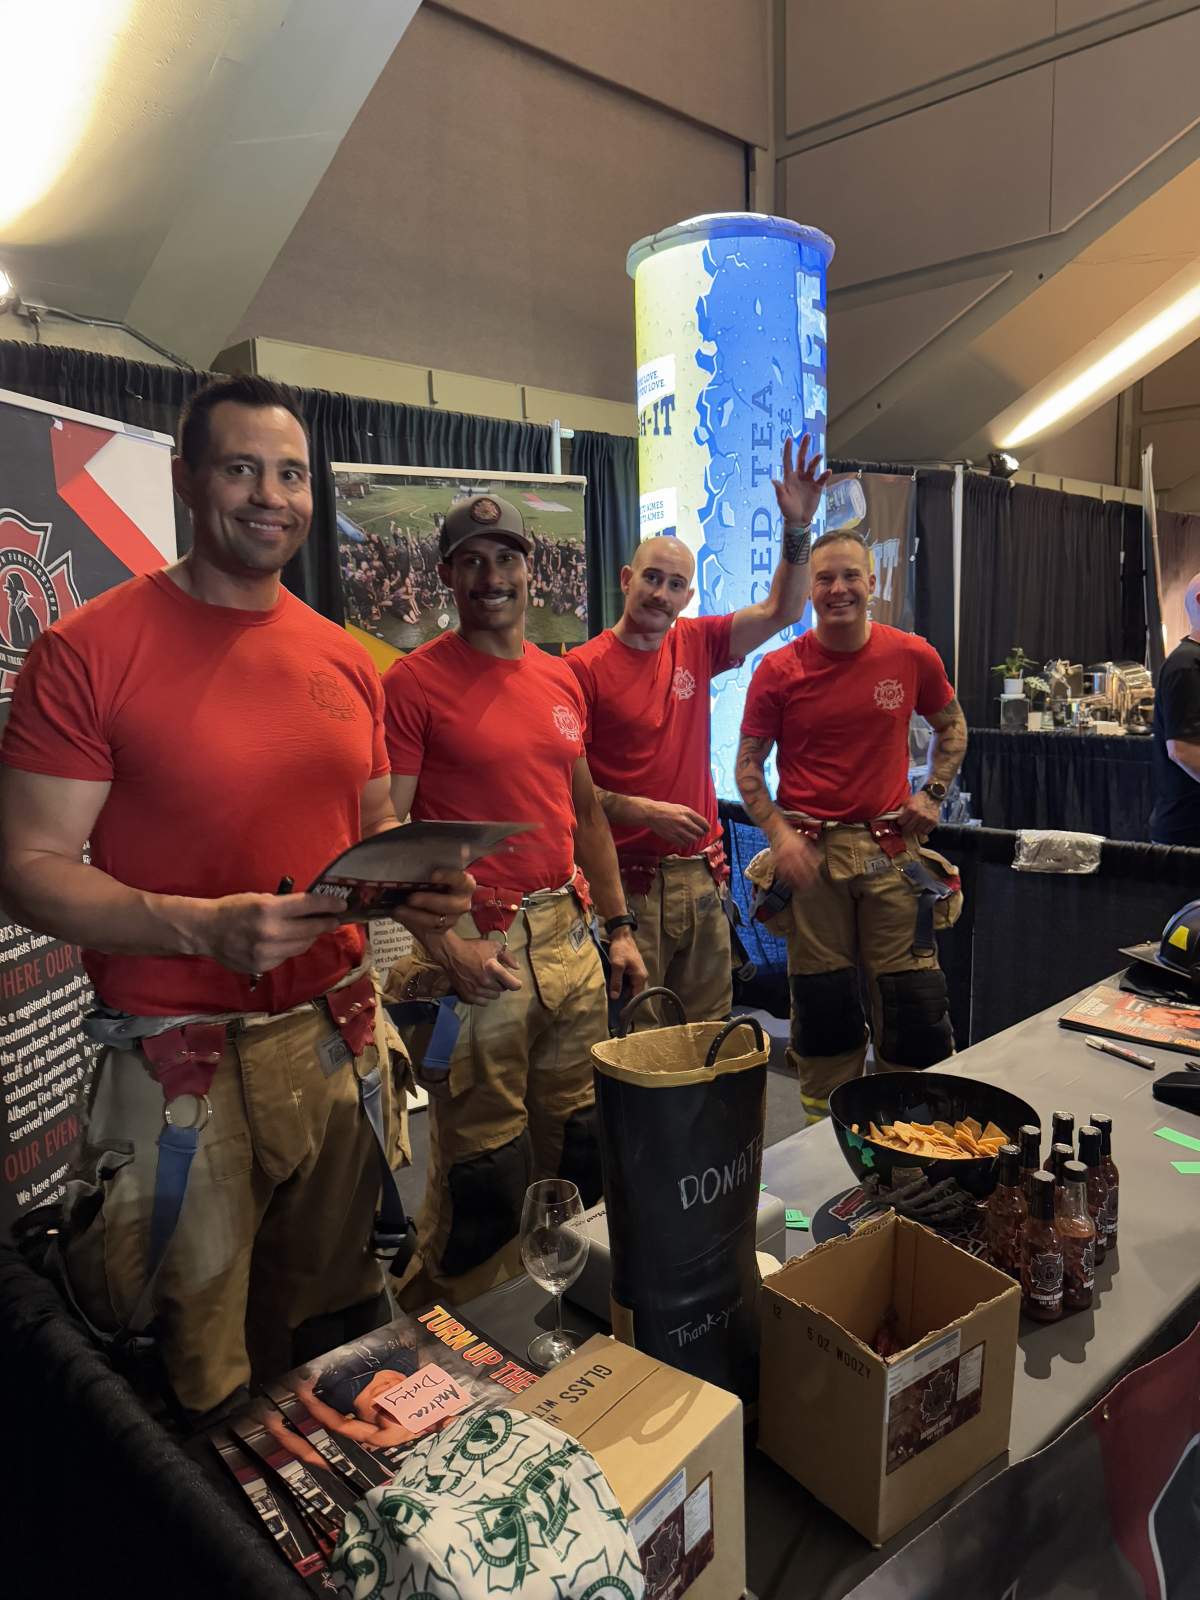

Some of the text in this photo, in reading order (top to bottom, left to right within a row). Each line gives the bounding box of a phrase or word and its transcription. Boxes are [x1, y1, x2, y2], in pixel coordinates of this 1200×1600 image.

[638, 394, 676, 437] H-IT
[751, 381, 773, 489] TEA
[0, 944, 74, 999] HERE OUR
[4, 1114, 79, 1183] OUR EVEN
[417, 1304, 479, 1352] TURN
[462, 1342, 504, 1367] UP
[383, 1374, 446, 1407] Dirty
[407, 1383, 460, 1420] Andrea
[559, 1364, 613, 1404] GLASS
[531, 1399, 559, 1419] WIT
